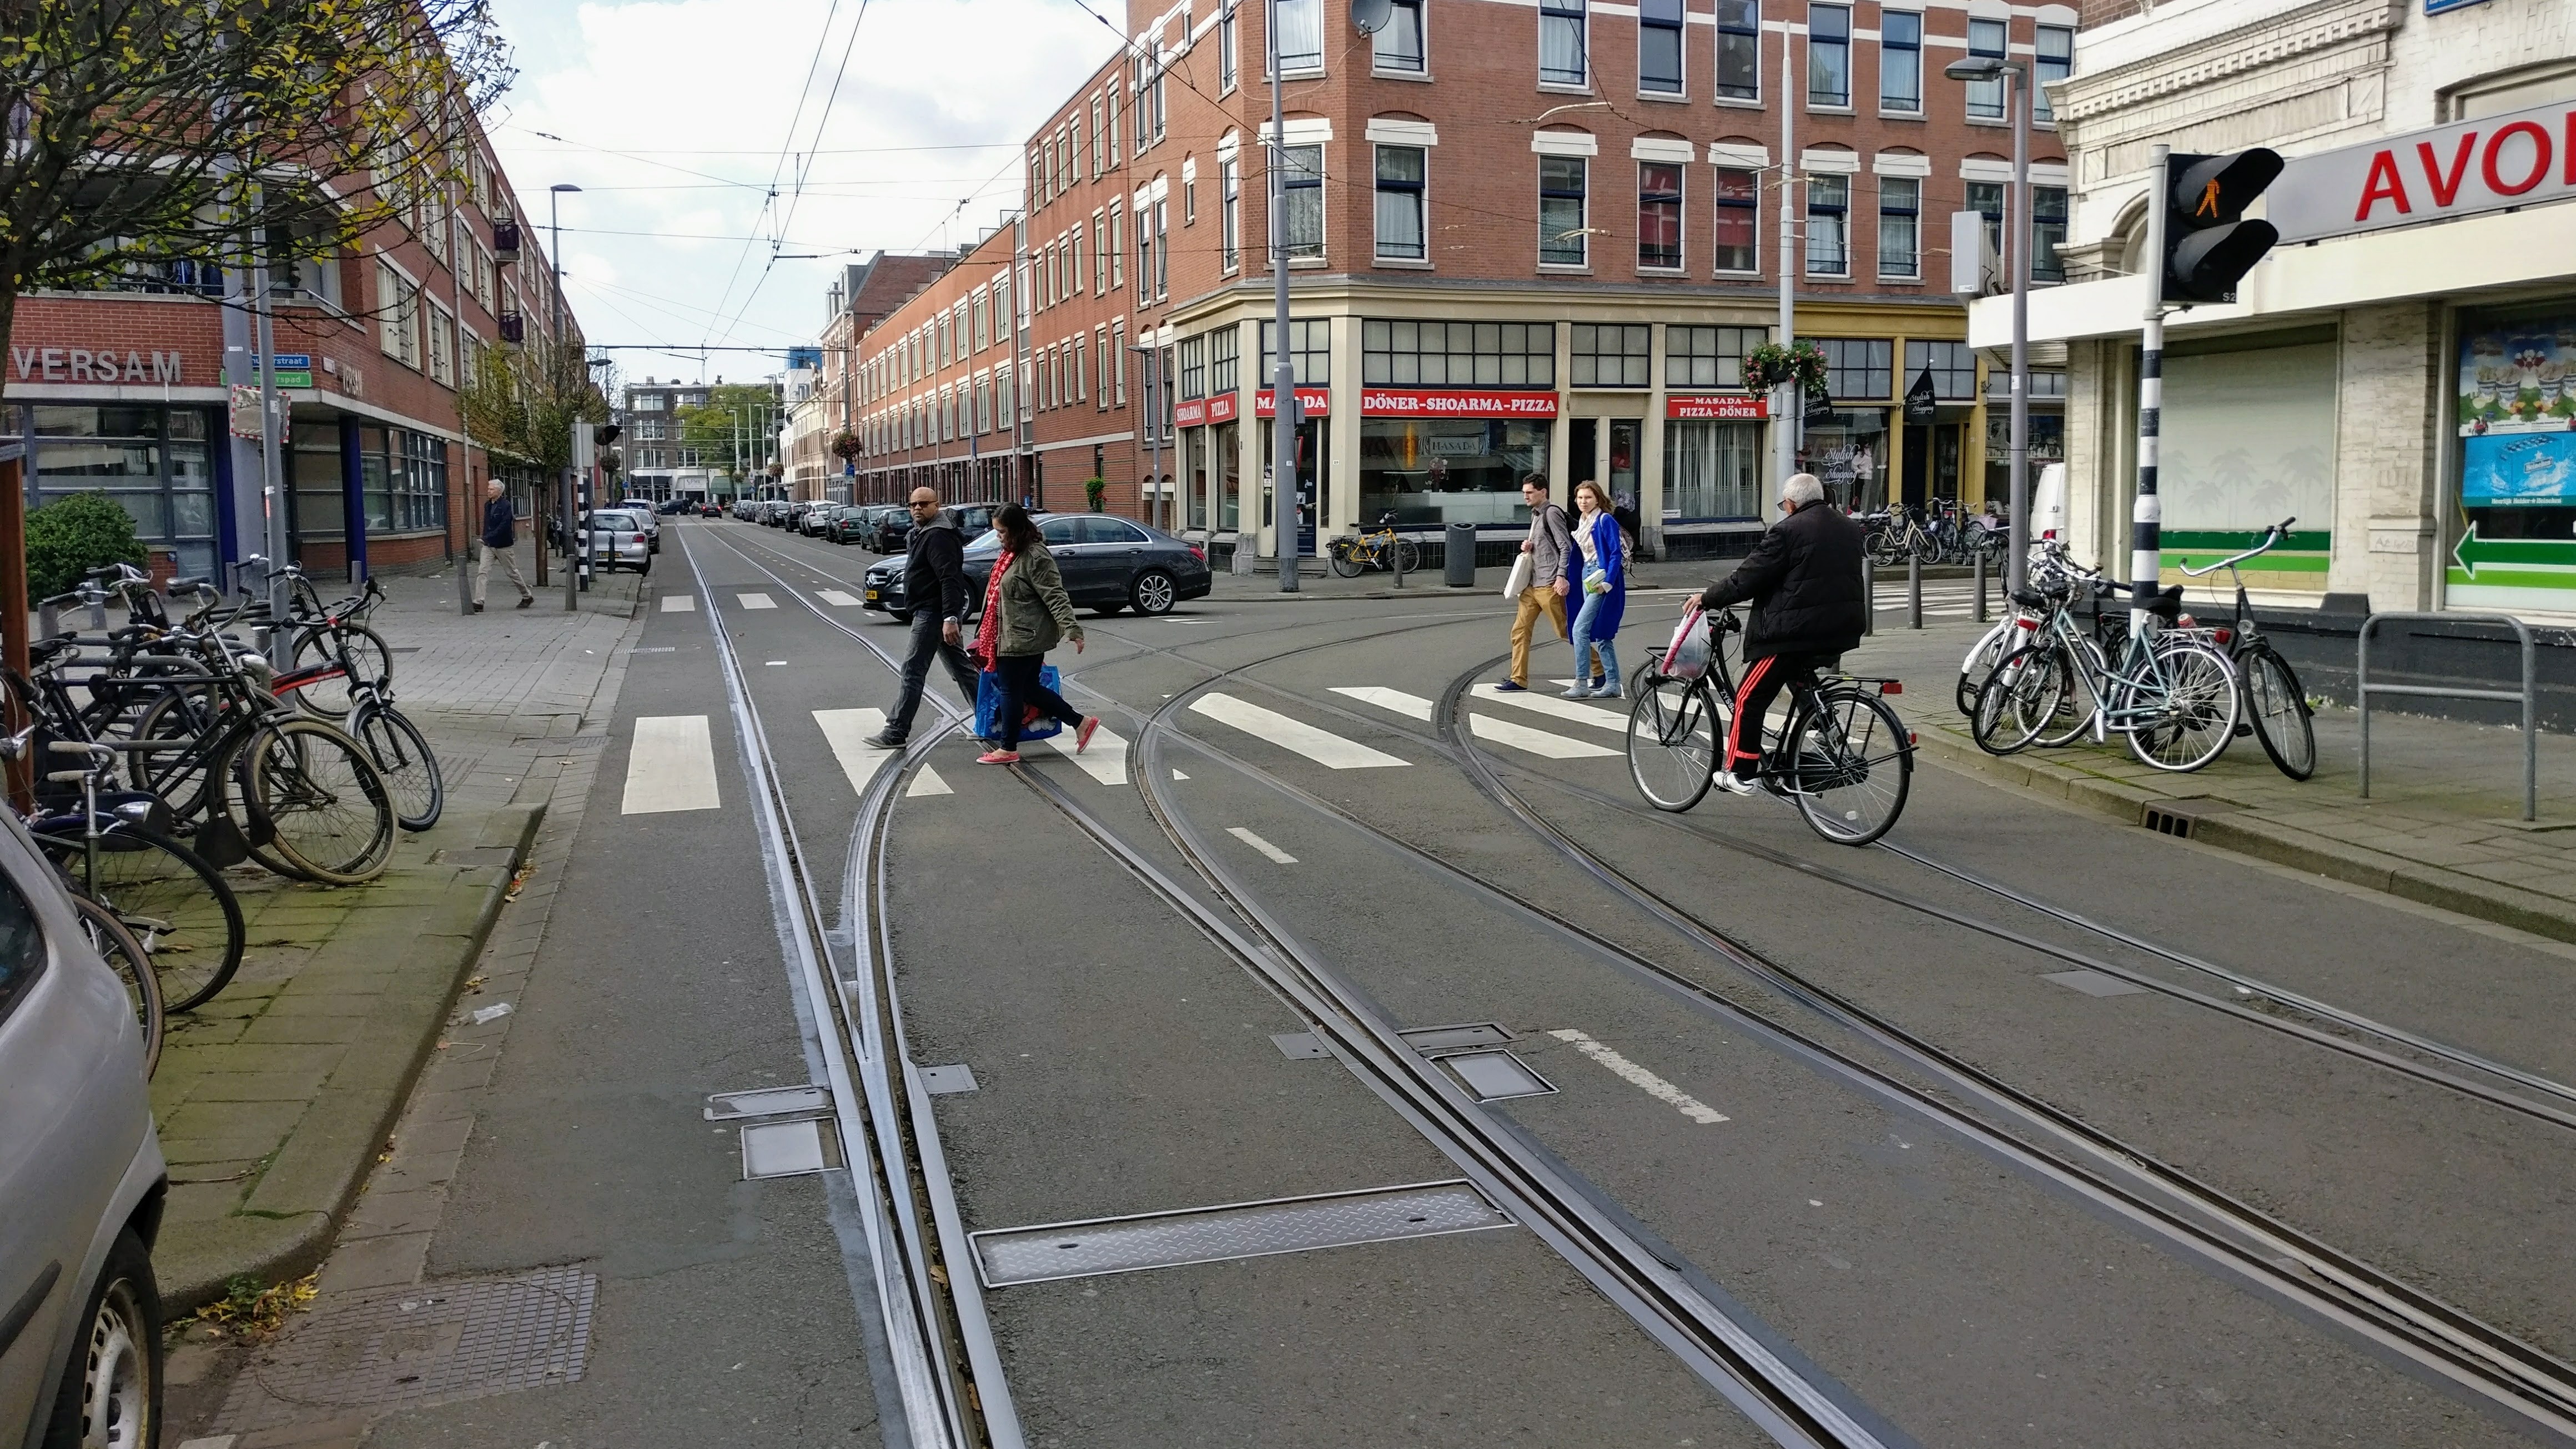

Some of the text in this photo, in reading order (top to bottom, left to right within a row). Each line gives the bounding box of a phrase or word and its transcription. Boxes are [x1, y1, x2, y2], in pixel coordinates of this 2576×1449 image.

[2222, 292, 2236, 301] S2
[12, 345, 182, 382] VERSAM
[1908, 390, 1933, 405] Stylish
[1176, 404, 1201, 422] SHOARMA
[1211, 399, 1229, 417] PIZZA
[1679, 406, 1757, 417] PIZZA-DÖNER
[1822, 444, 1860, 466] Stylish
[1823, 464, 1858, 485] Shopping
